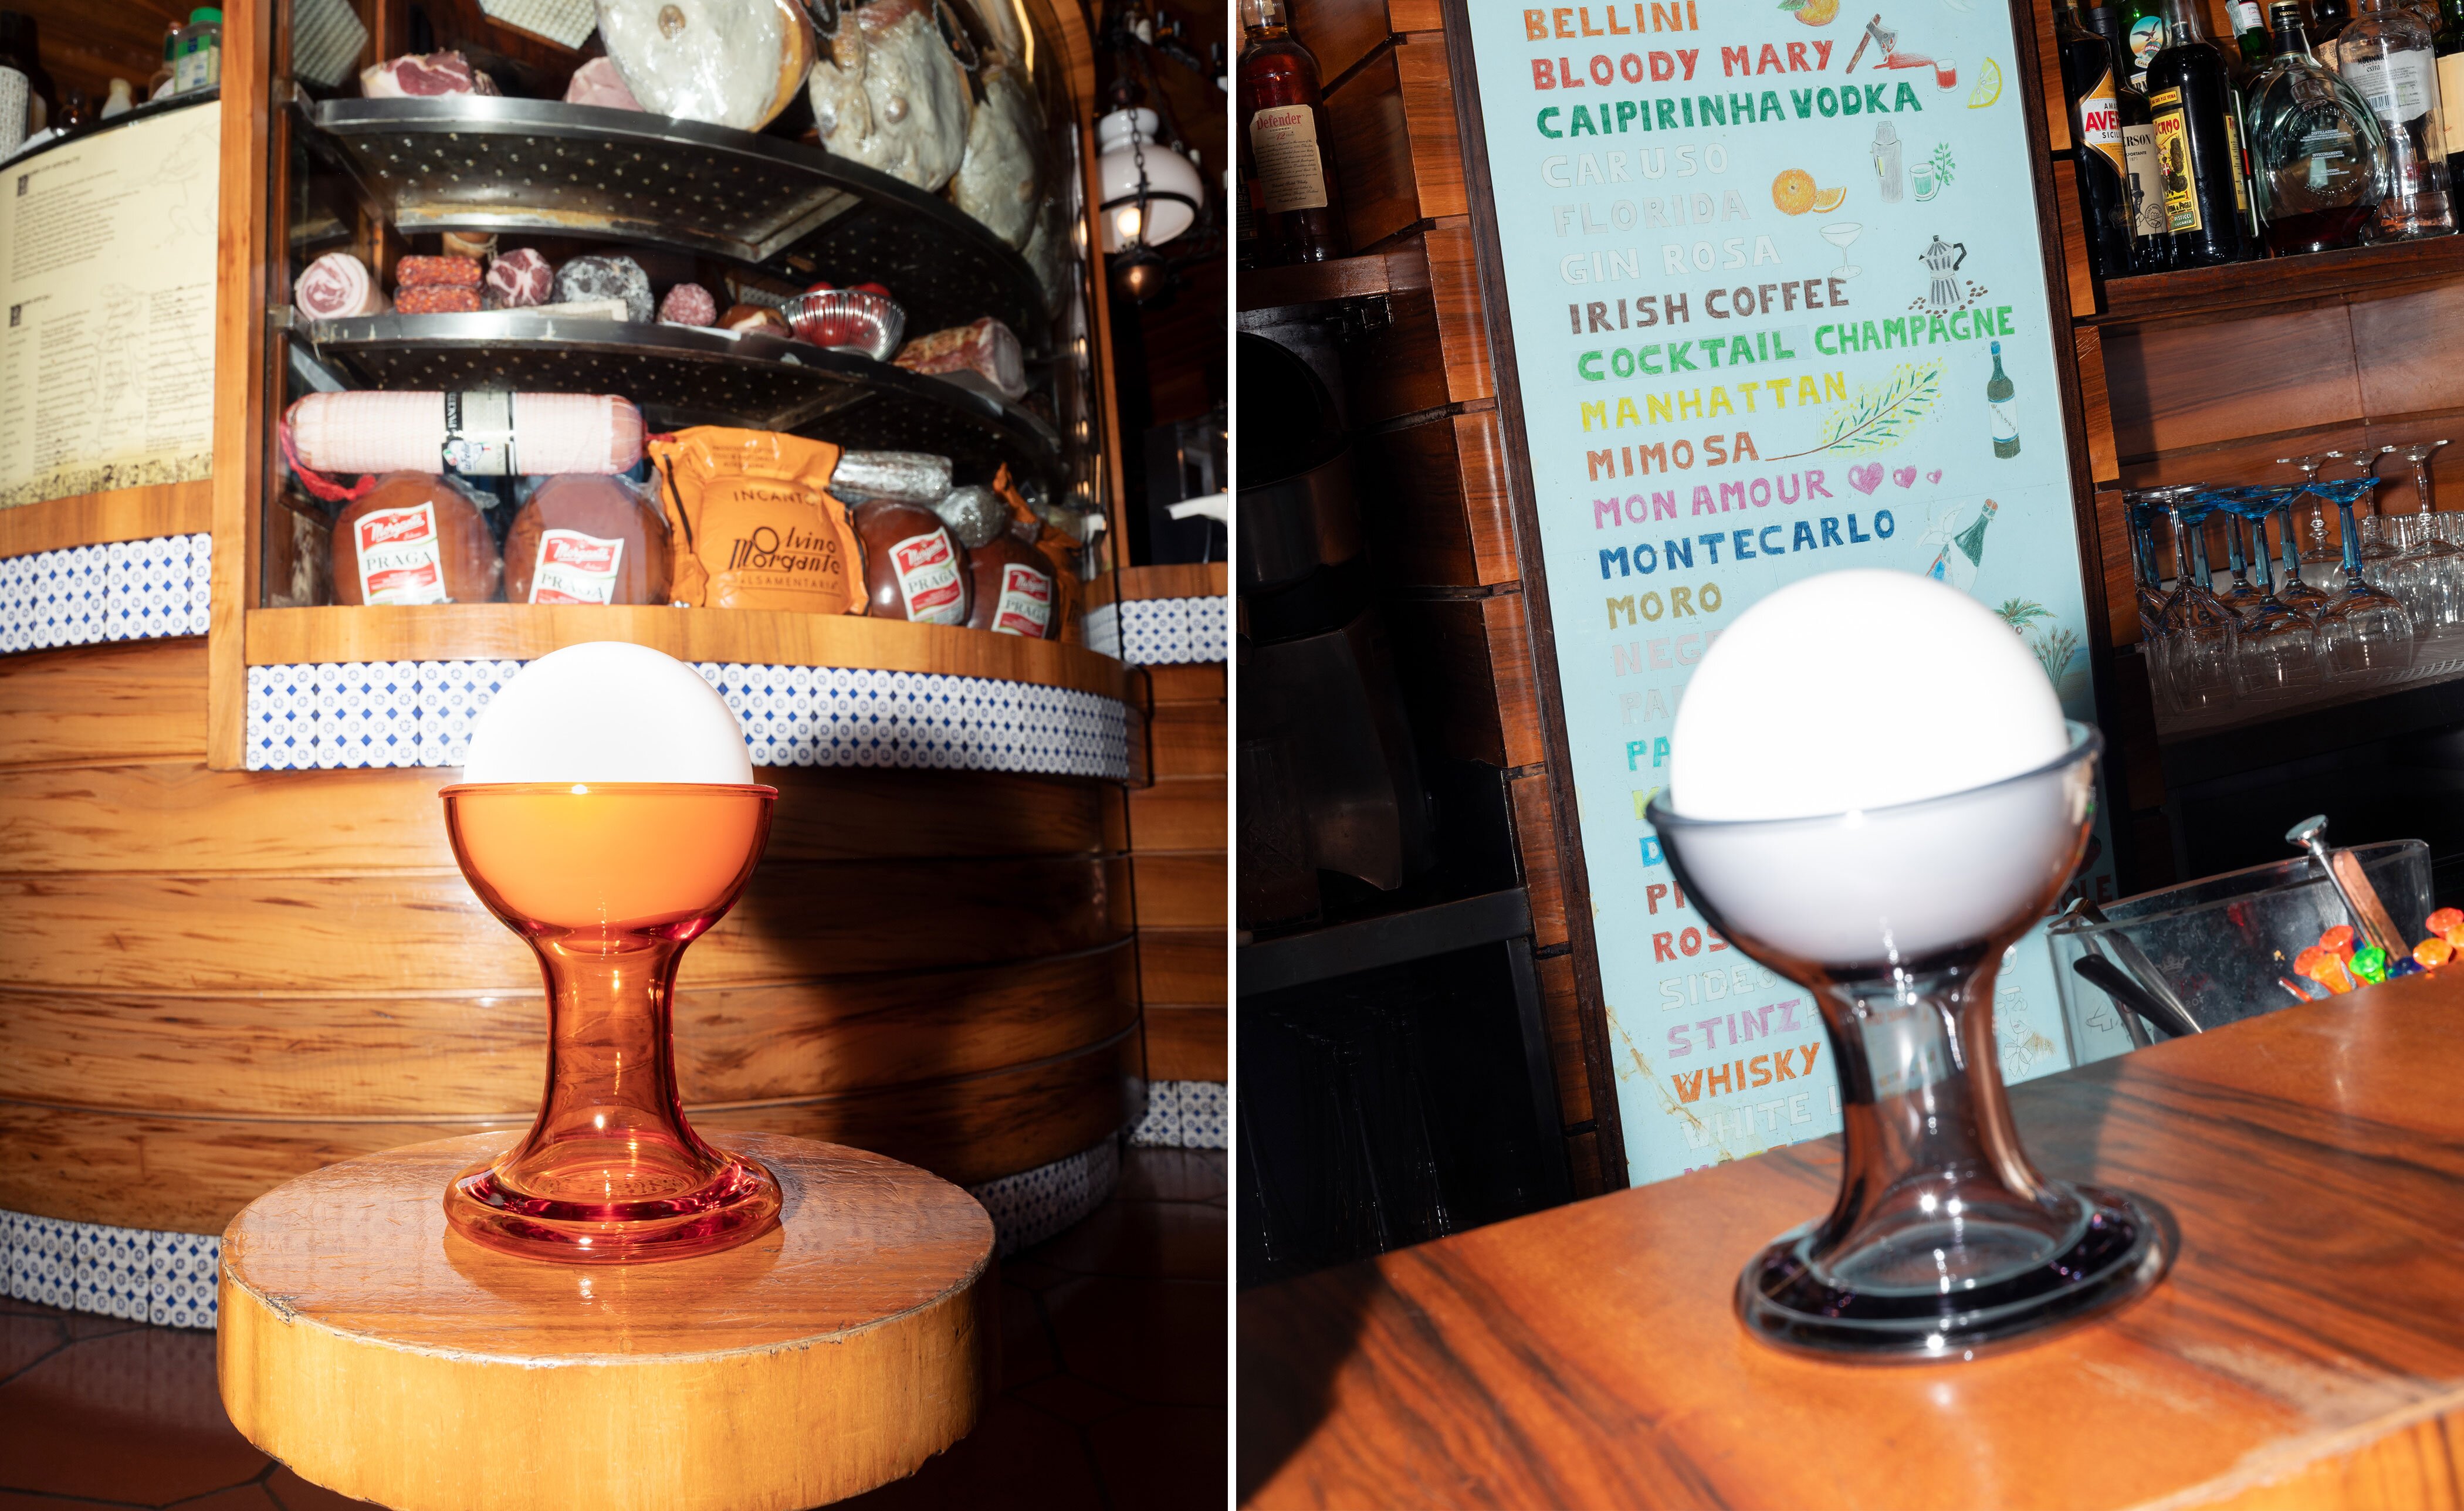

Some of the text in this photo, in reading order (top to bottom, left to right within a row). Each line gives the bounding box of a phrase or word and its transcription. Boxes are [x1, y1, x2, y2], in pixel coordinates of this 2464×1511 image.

[1525, 0, 1700, 42] BELLINI
[1531, 39, 1835, 92] BLOODY MARY
[1257, 113, 1302, 130] Defender
[1536, 81, 1924, 139] CAIPIRINHA VODKA
[1541, 143, 1728, 189] CARUSO
[1552, 189, 1752, 238] FLORIDA
[1559, 235, 1783, 286] GIN ROSA
[1568, 277, 1850, 334] IRISH COFFEE
[1578, 304, 2016, 382] COCKTAIL CHAMPAGNE
[1580, 371, 1849, 433] MANHATTAN
[1991, 404, 2016, 433] WHISKY
[1586, 431, 1760, 482] MIMOSA
[1593, 468, 1835, 530] MON AMOUR
[366, 551, 433, 571] PRAGA
[1599, 509, 1896, 580] MONTECARLO
[1606, 582, 1723, 631] MORO
[1671, 1042, 1821, 1104] WHISKY
[1680, 1092, 1812, 1150] WHITE
